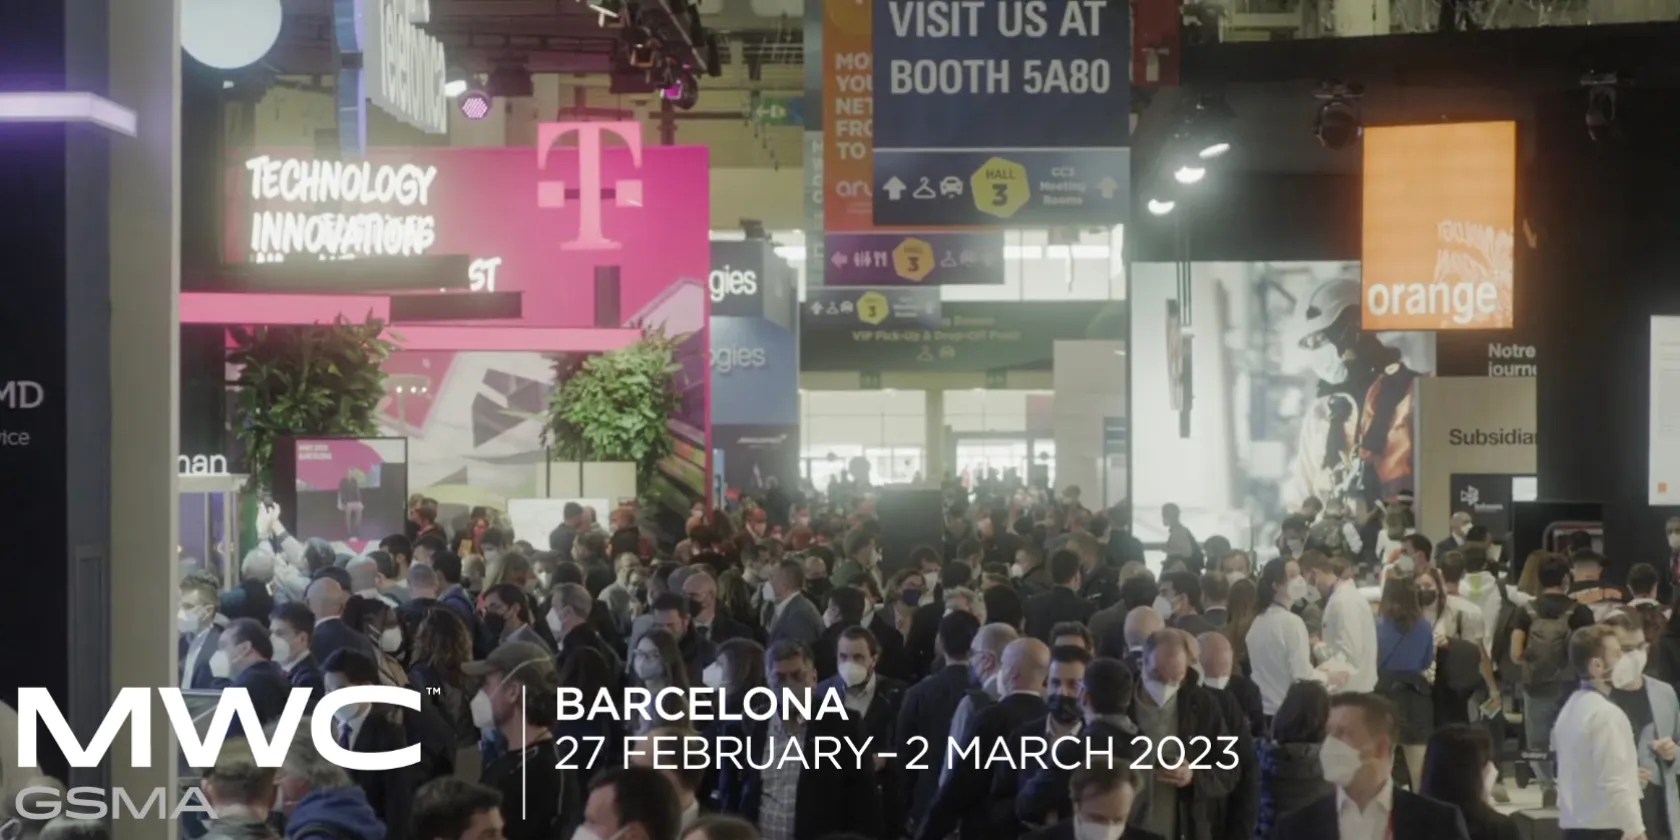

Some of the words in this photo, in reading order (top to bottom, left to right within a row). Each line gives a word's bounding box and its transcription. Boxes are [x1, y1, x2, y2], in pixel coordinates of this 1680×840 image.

[888, 1, 984, 37] VISIT
[998, 1, 1048, 37] US
[1059, 1, 1106, 37] AT
[835, 52, 873, 70] MO
[890, 59, 1009, 94] BOOTH
[1023, 59, 1110, 94] 5A80
[836, 142, 866, 160] TO
[246, 155, 437, 206] TECHNOLOGY
[986, 169, 1015, 180] HALL
[992, 183, 1008, 206] 3
[908, 257, 919, 272] 3
[868, 305, 877, 318] 3
[1368, 281, 1498, 325] orange
[1488, 343, 1536, 358] Notre
